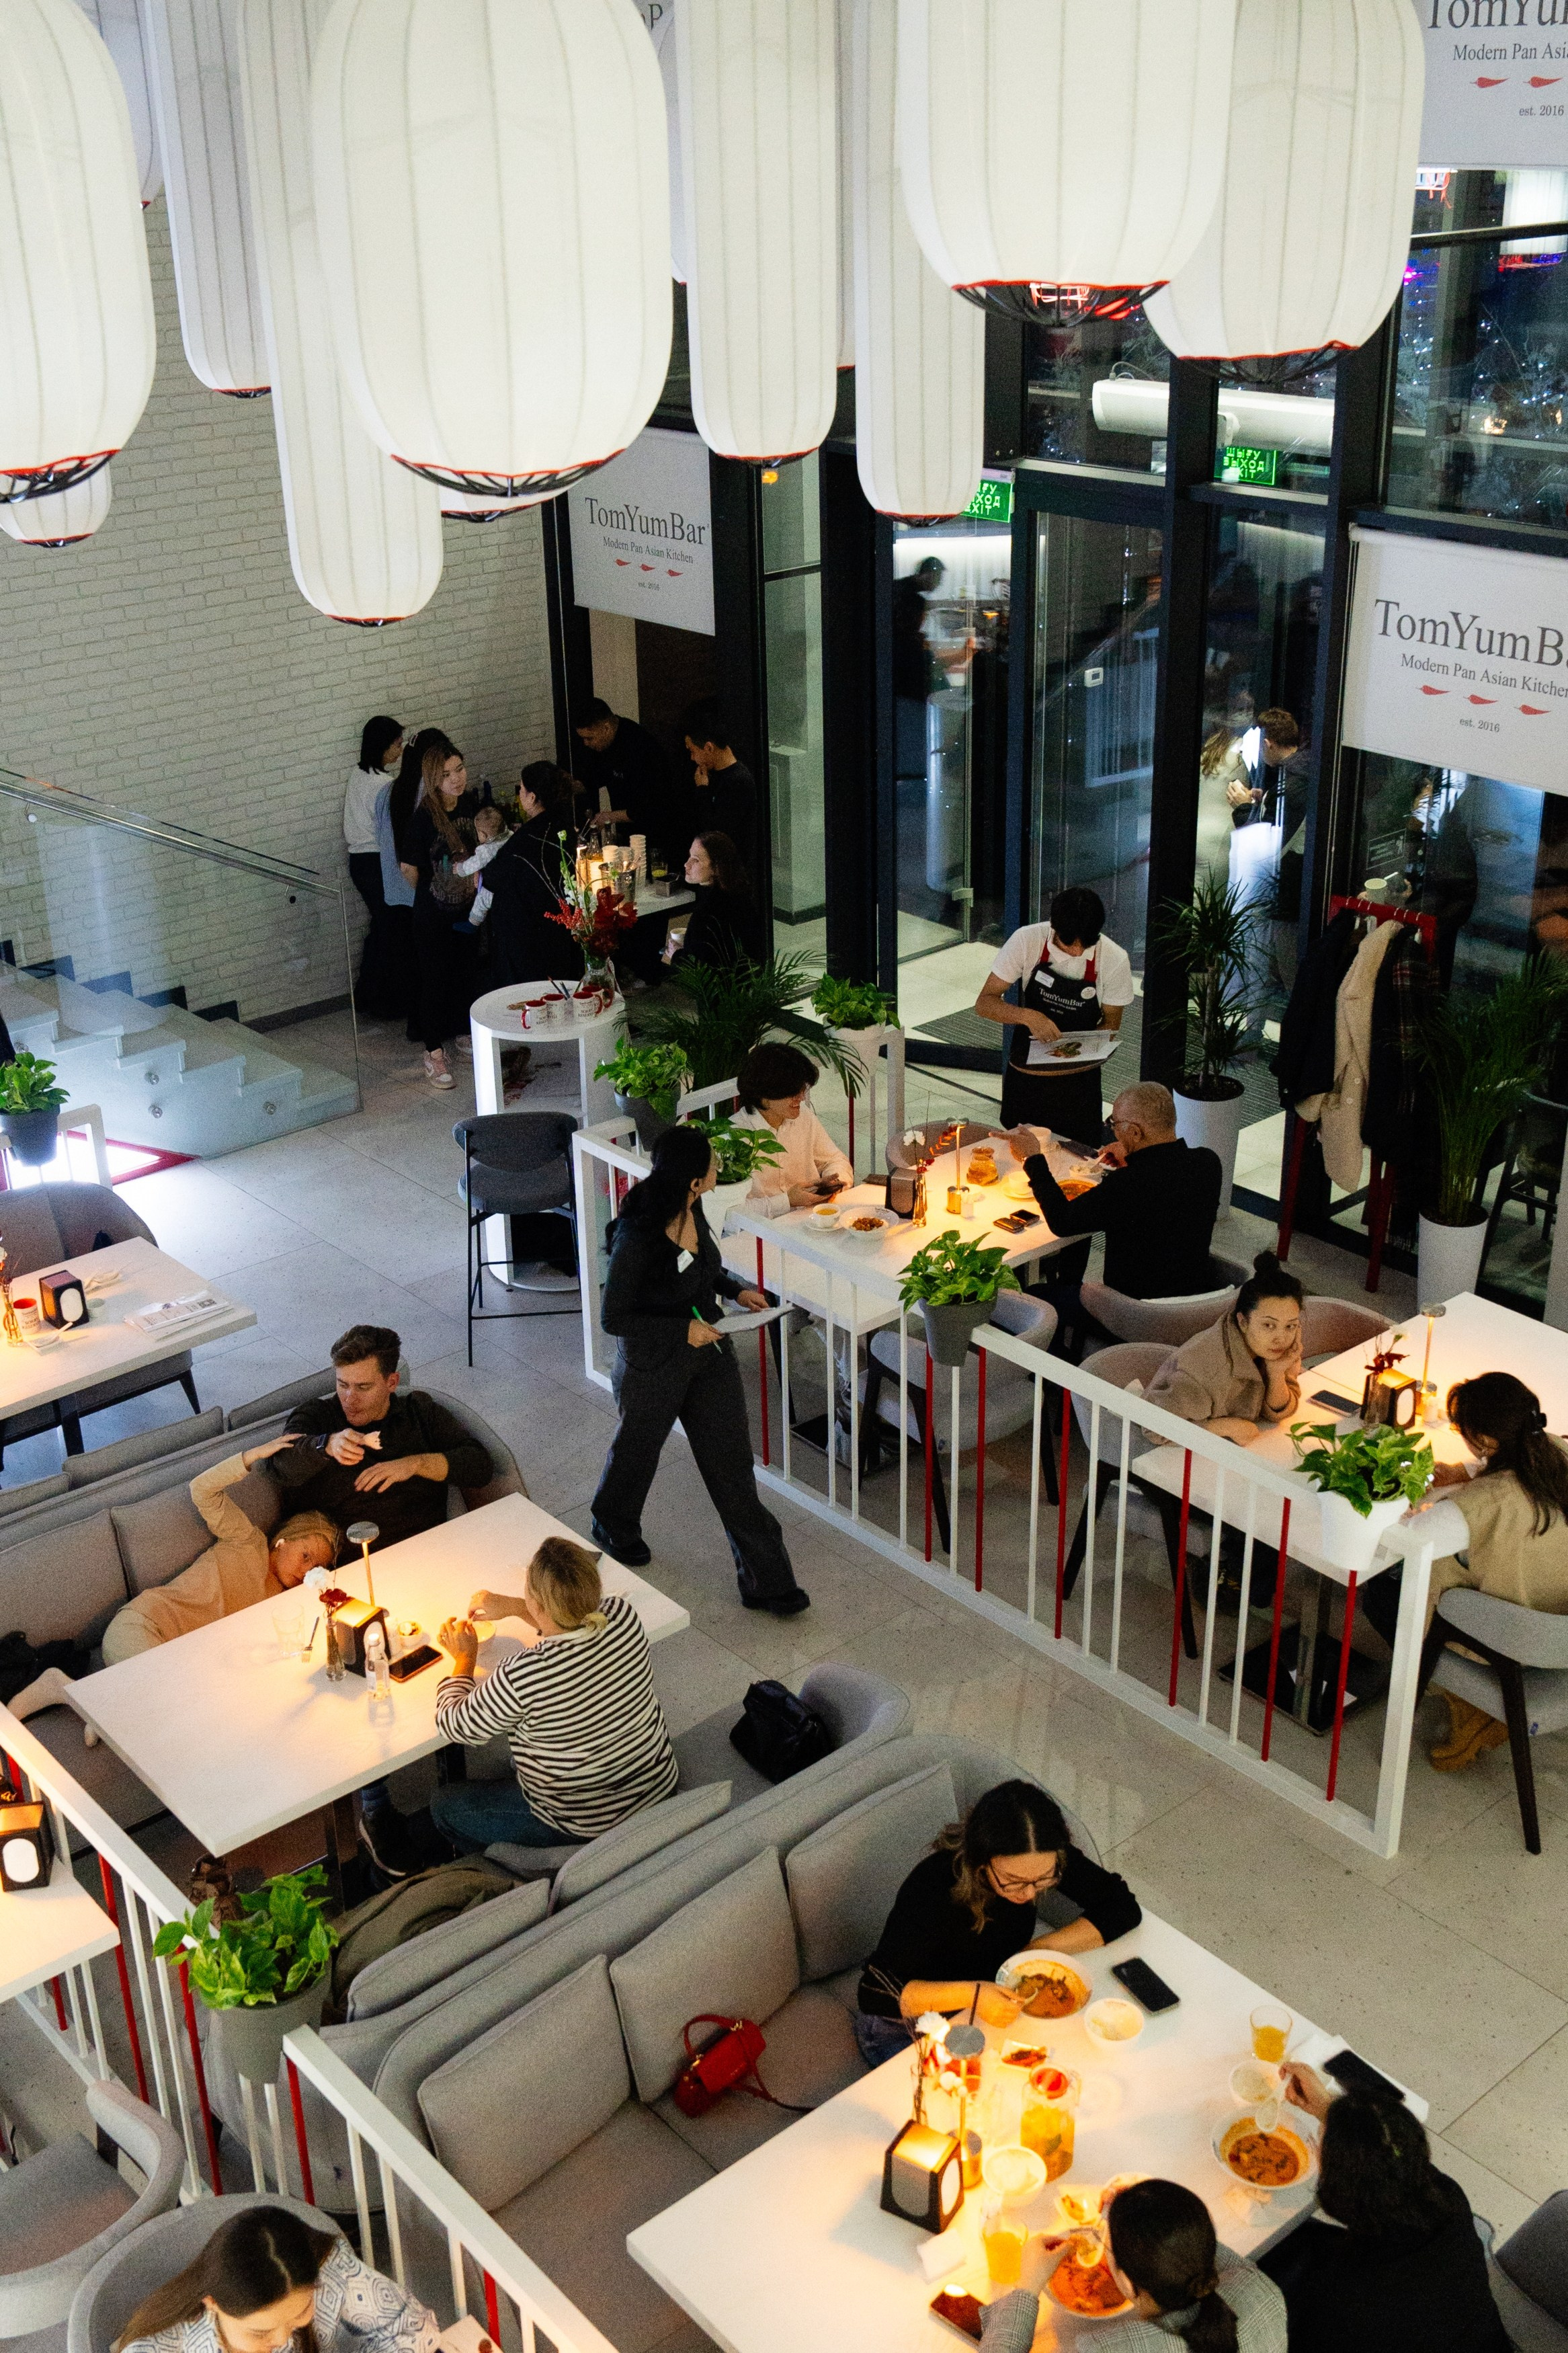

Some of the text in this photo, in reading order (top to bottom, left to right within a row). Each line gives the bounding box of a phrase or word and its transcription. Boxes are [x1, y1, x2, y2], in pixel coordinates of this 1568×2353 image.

[1428, 0, 1568, 29] TomYu
[1452, 42, 1568, 61] Modern Pan Asi
[1519, 105, 1564, 116] est. 2016
[1223, 456, 1265, 473] ВЫХОД
[585, 497, 706, 545] TomYumBar
[603, 536, 694, 563] Modern Pan Asian Kitchen
[648, 582, 661, 591] 2016
[1374, 598, 1568, 668] TomYumB
[1401, 653, 1449, 676] Modern
[1452, 664, 1476, 680] Pan
[1480, 669, 1517, 688] Asian
[1459, 717, 1500, 733] est. 2016
[1039, 988, 1085, 1007] TomYumBar
